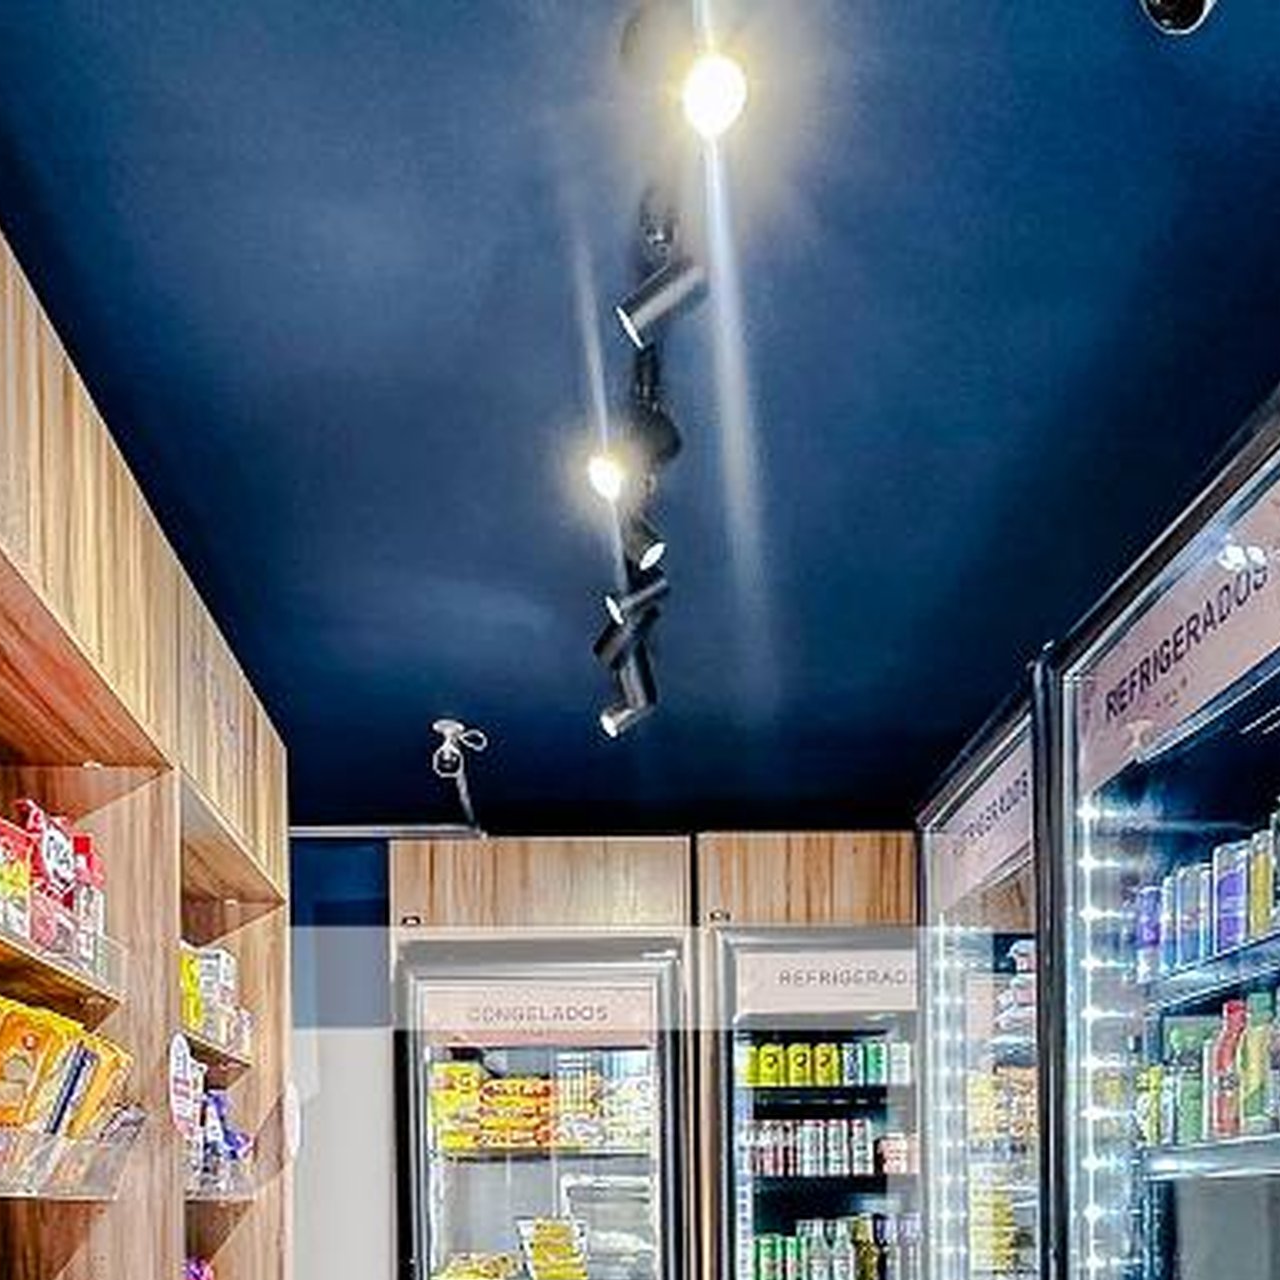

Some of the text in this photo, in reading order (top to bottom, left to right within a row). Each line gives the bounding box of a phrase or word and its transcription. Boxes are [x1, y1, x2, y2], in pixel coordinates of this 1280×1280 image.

[1104, 566, 1269, 722] REFRIGERADOS
[778, 968, 913, 986] REFRIGERAD
[467, 1005, 608, 1022] CONGELADOS
